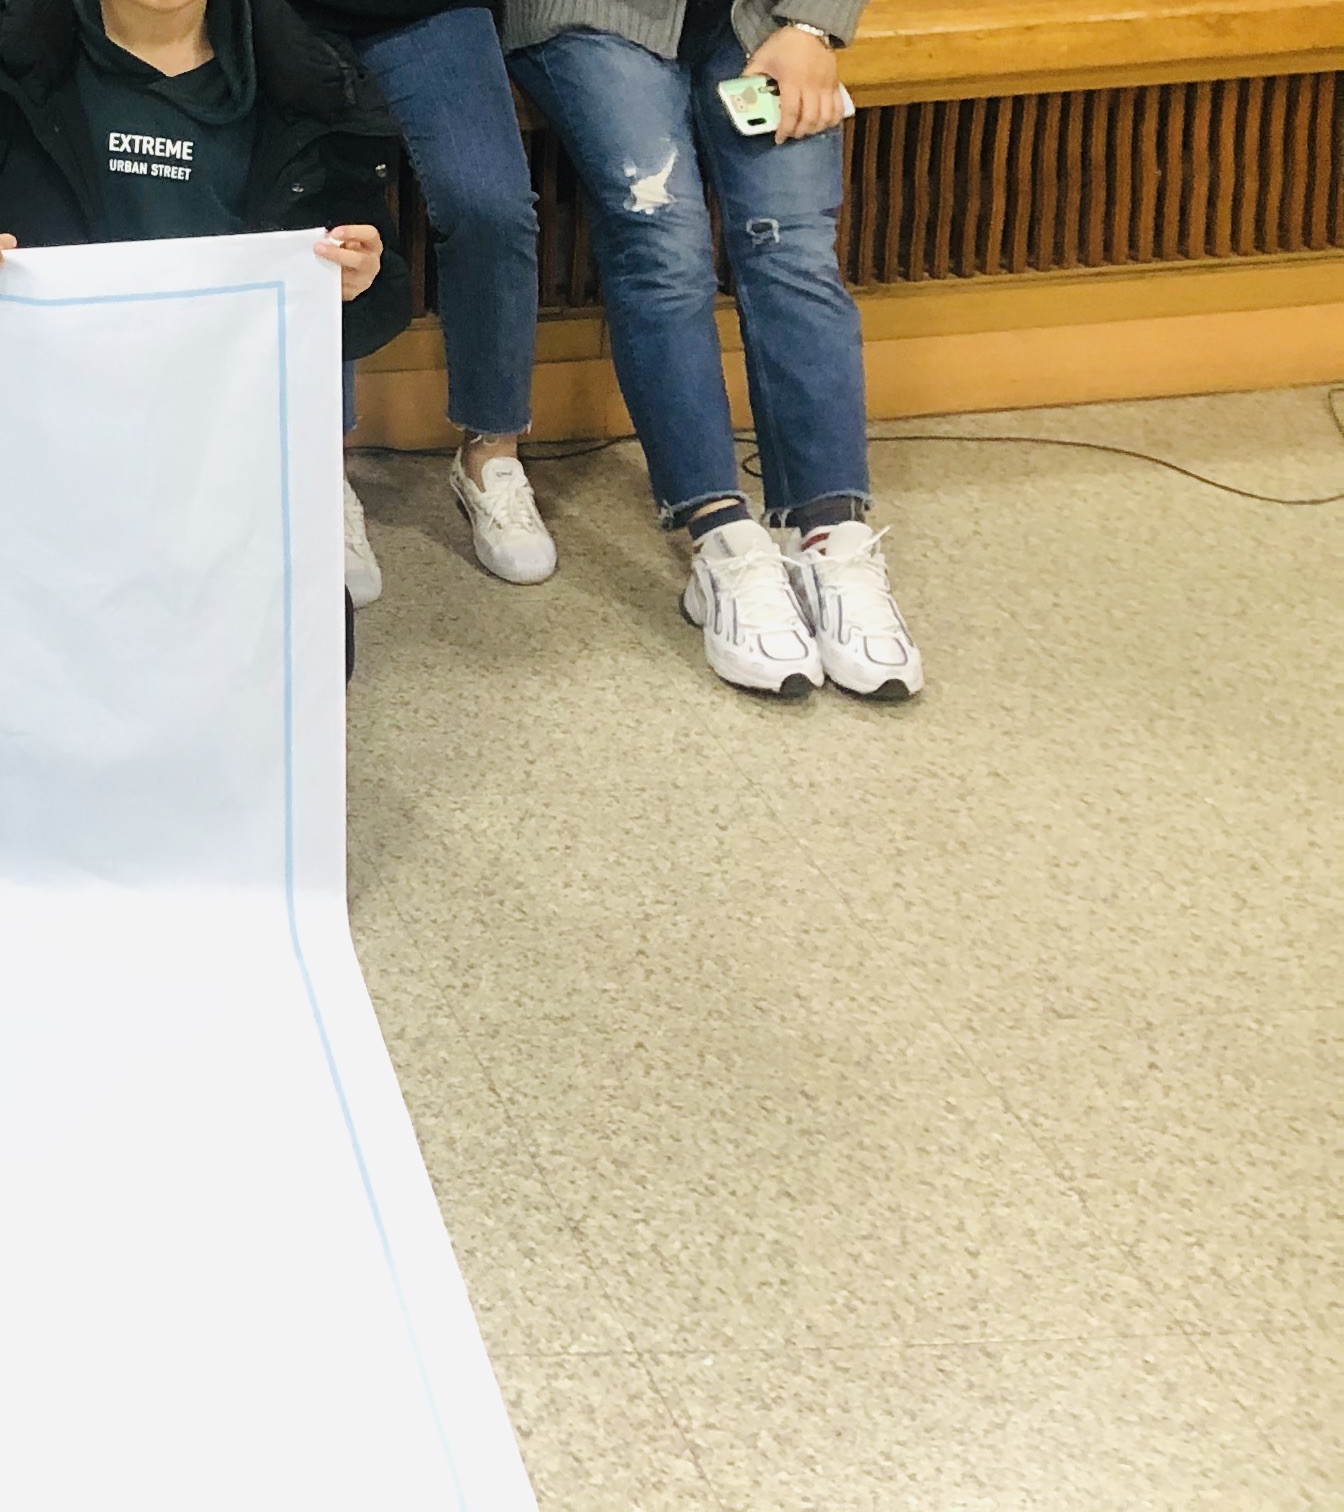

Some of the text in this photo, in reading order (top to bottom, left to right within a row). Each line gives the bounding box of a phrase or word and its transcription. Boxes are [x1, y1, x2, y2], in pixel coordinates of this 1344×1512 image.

[108, 132, 194, 161] EXTREME
[109, 158, 192, 181] URBAN STREET
